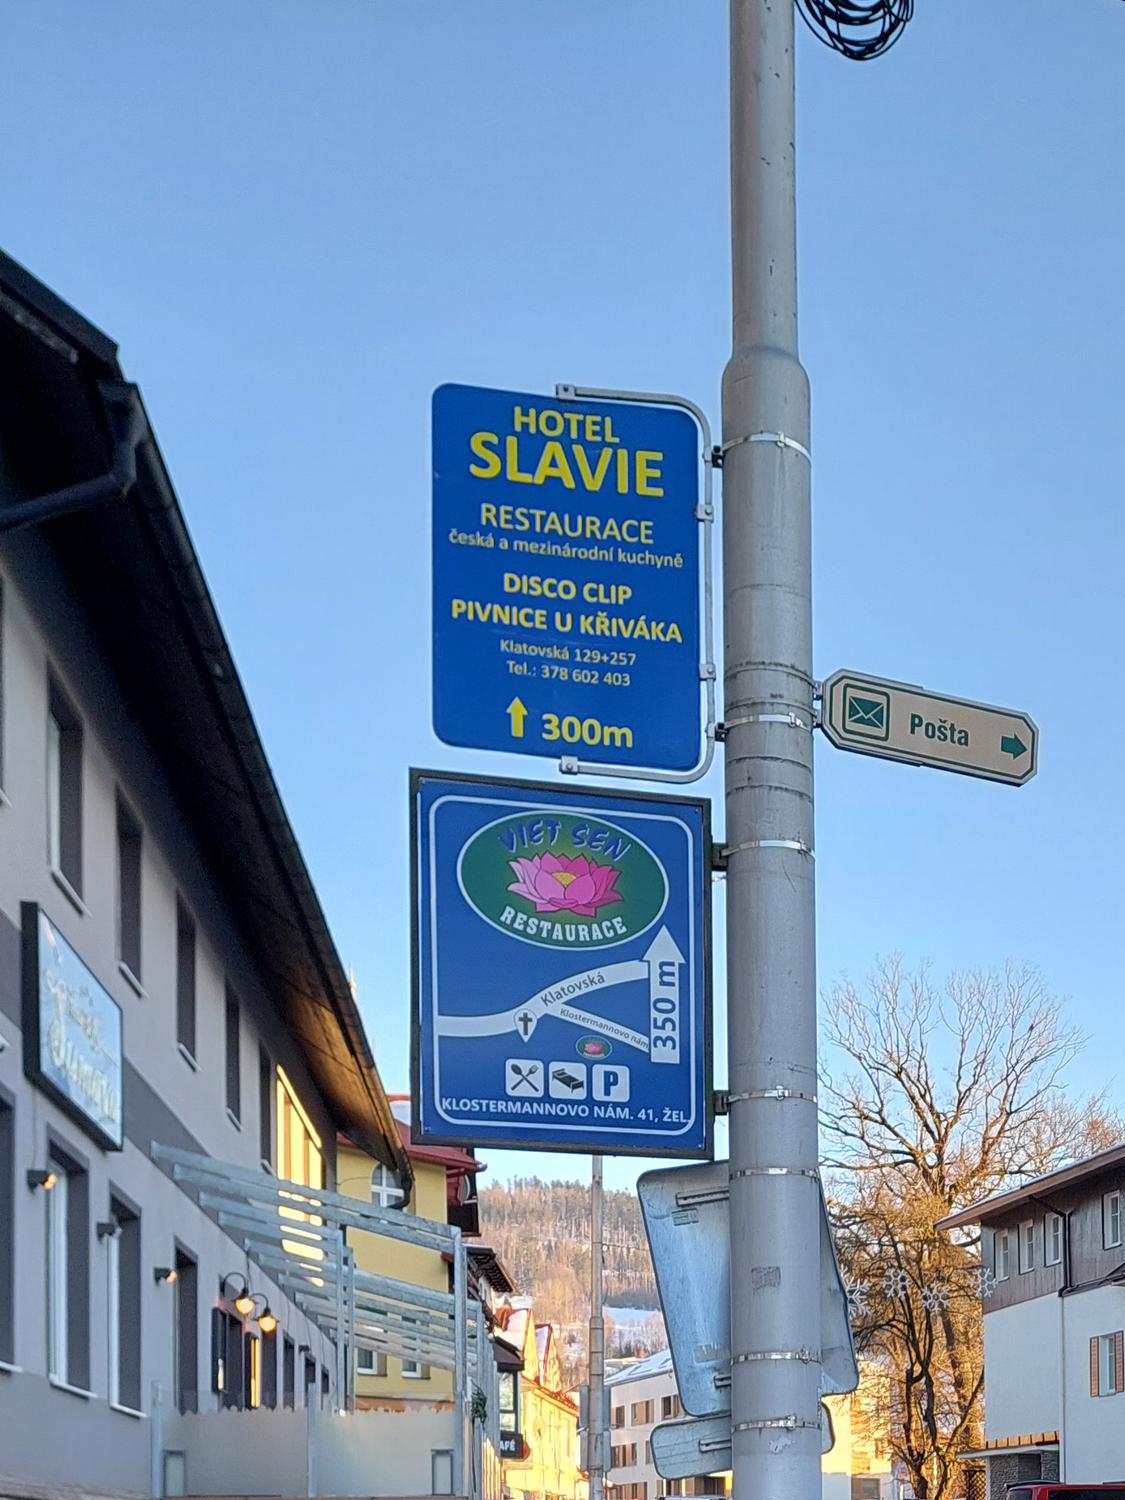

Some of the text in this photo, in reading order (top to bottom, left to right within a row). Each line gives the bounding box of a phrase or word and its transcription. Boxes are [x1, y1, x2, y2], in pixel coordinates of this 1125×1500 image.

[514, 406, 620, 443] HOTEL
[469, 431, 664, 497] SLAVIE
[481, 502, 654, 544] RESTAURACE
[448, 528, 684, 568] česká a mezinárodní kuchyně
[503, 573, 632, 605] DISCO CLIP
[451, 599, 683, 644] PIVNICE U KŘIVÁKA
[500, 639, 636, 666] Klatovská 129+257
[506, 660, 630, 686] Tel.: 378 602 403
[542, 713, 633, 748] 300m
[909, 712, 969, 747] Pošta
[498, 819, 632, 862] VIET SEN
[499, 905, 627, 942] RESTAURACE
[540, 971, 606, 1007] Klatovská
[652, 960, 677, 1050] 350 m
[560, 1008, 630, 1039] Klostermannovo
[603, 1070, 619, 1096] P
[441, 1097, 589, 1117] KLOSTERMANNOVO
[593, 1105, 634, 1120] NÁM.
[637, 1108, 658, 1123] 41,
[499, 1438, 516, 1451] AFÉ
